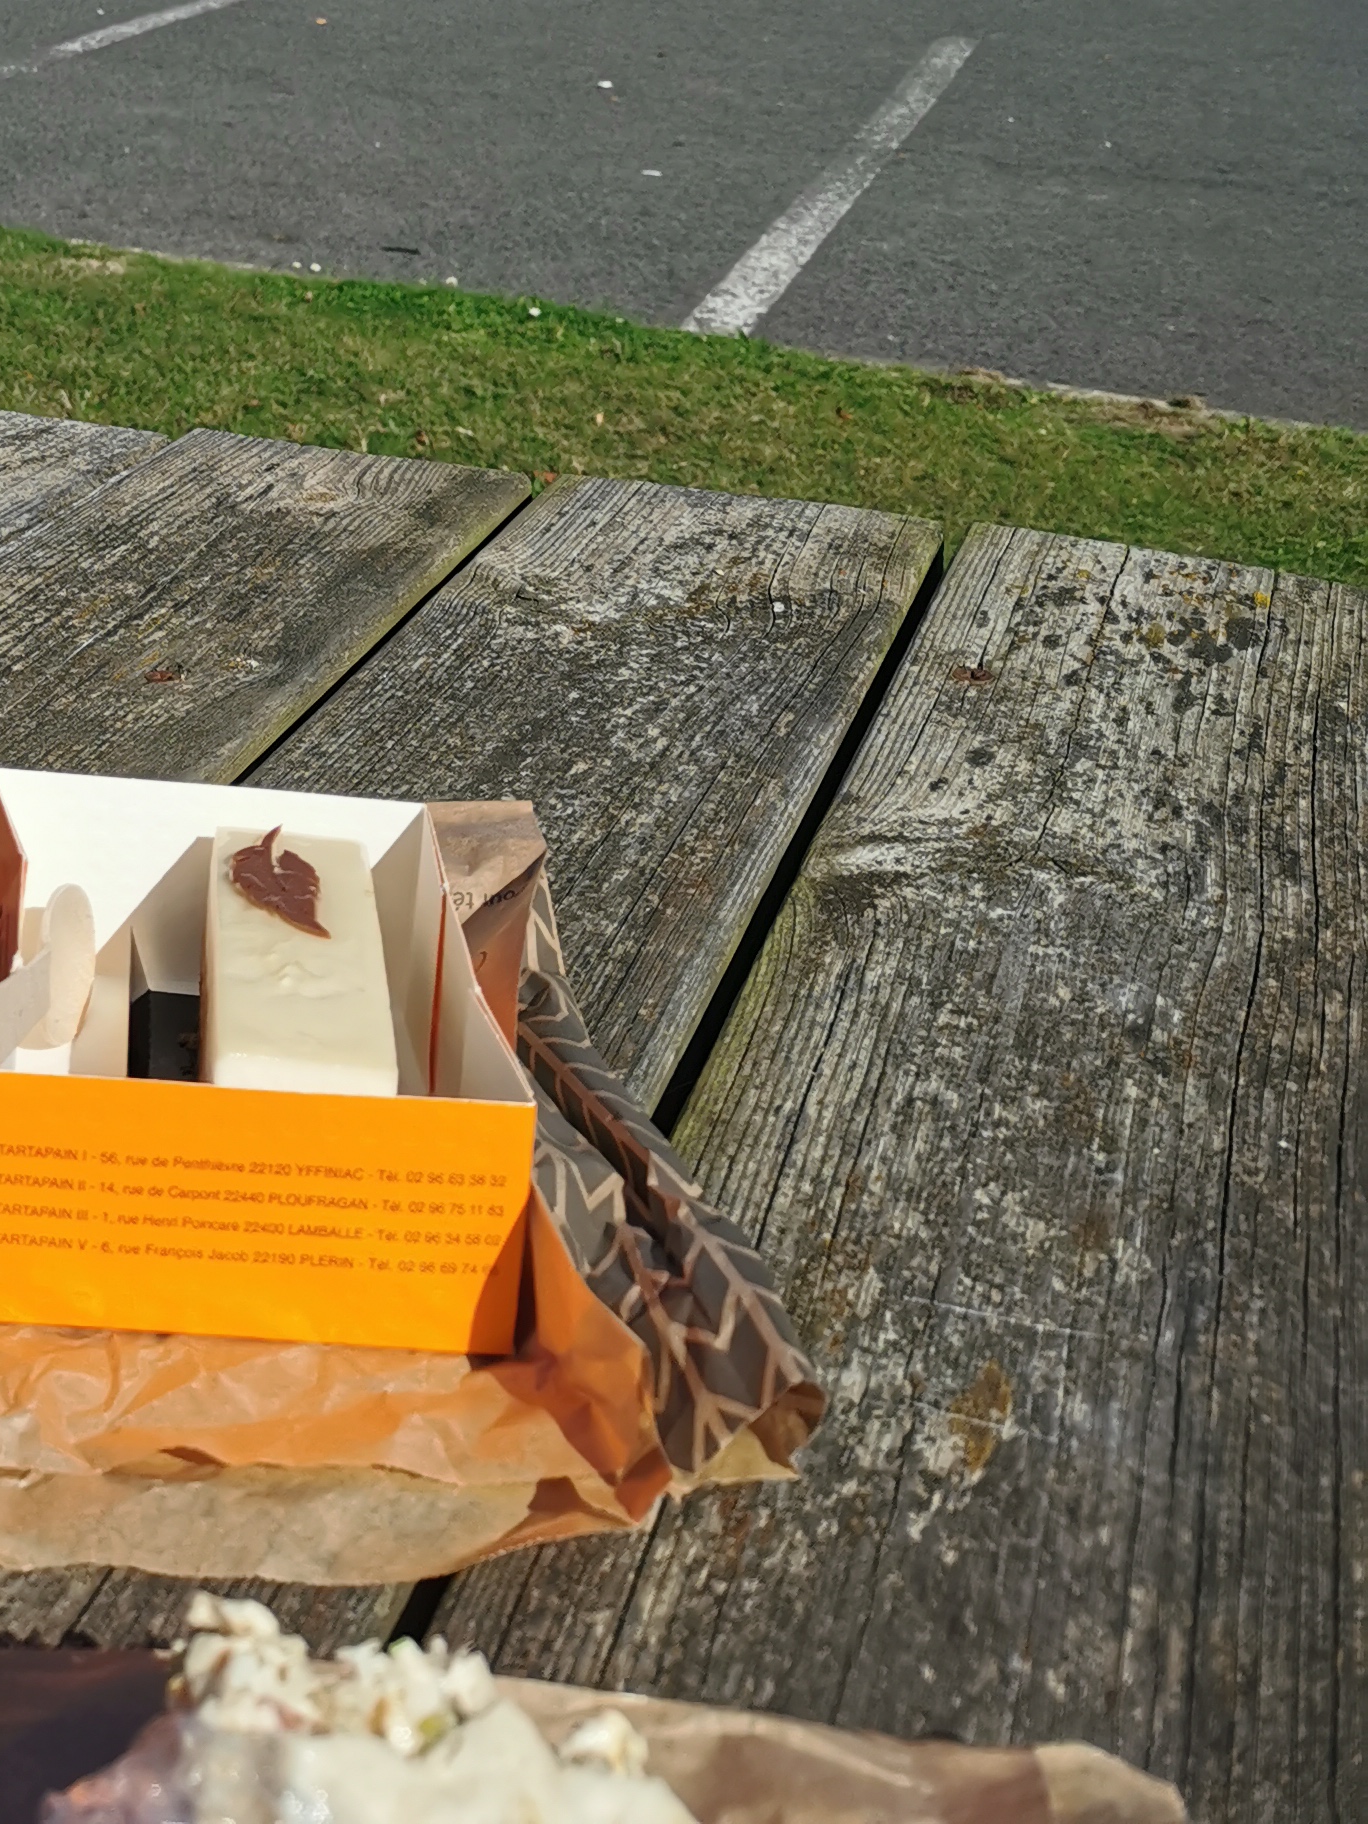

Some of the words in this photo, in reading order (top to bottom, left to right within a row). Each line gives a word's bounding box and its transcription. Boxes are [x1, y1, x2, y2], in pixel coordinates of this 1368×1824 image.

[125, 1155, 148, 1166] rue
[151, 1155, 169, 1167] de
[295, 1162, 364, 1181] YFFINIAC
[122, 1185, 144, 1195] rue
[147, 1185, 164, 1197] de
[268, 1192, 368, 1210] PLOUFRAGAN
[117, 1214, 139, 1225] rue
[288, 1224, 363, 1239] LAMBALLE
[77, 1238, 88, 1250] V
[118, 1244, 141, 1255] rue
